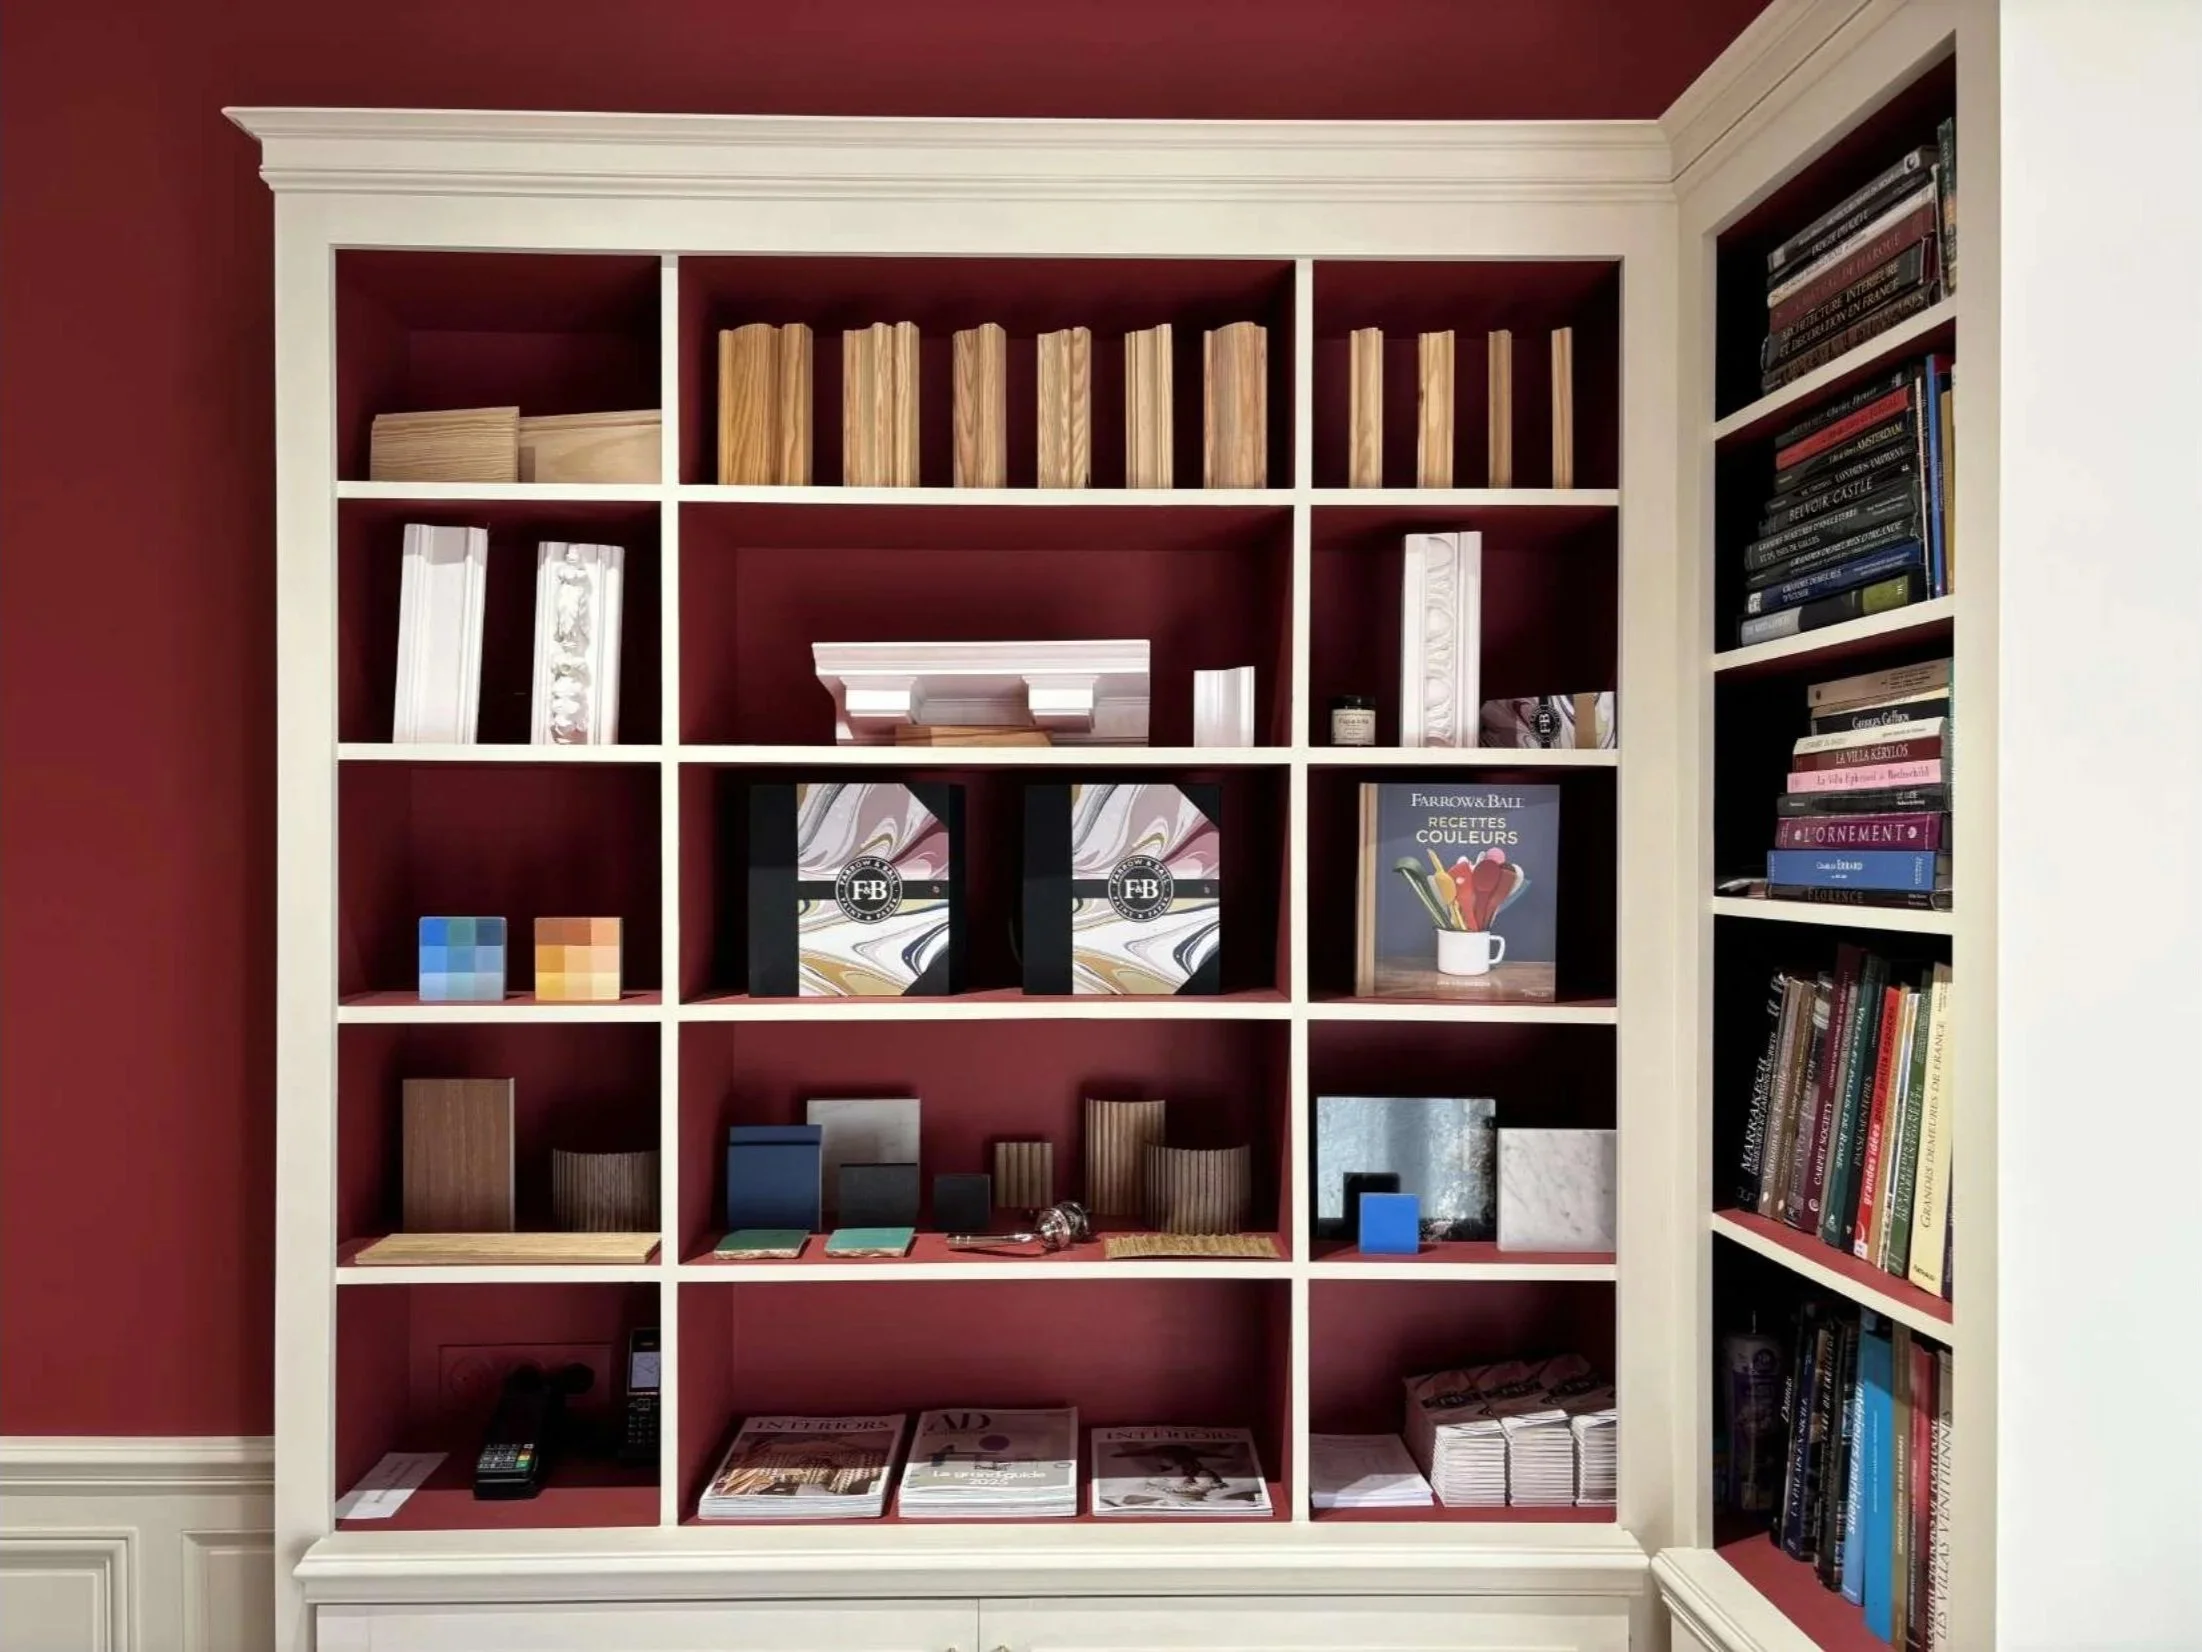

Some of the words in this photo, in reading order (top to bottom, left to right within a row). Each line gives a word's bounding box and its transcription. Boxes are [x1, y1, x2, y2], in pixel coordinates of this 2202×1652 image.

[1789, 492, 1830, 522] BELVOIR
[1834, 476, 1872, 504] CASTLE
[1847, 749, 1869, 763] VILLA
[1428, 817, 1507, 828] RECETTES
[1804, 824, 1905, 842] L'ORNEMENT
[1416, 829, 1518, 844] COULEURS
[841, 860, 871, 884] FARROW
[1112, 858, 1143, 884] FARROW
[852, 880, 888, 900] F&B
[1124, 879, 1159, 899] F&B
[840, 897, 862, 919] PAINT
[1932, 1022, 1944, 1070] FRANCE
[1930, 1074, 1940, 1092] DE
[1740, 1056, 1767, 1172] MARRAKECH
[1818, 1101, 1832, 1144] SOCIETY
[1866, 1124, 1880, 1155] idées
[1925, 1096, 1938, 1163] DEMEURES
[1836, 1131, 1846, 1168] ROME
[1814, 1147, 1828, 1185] CARPET
[1863, 1158, 1876, 1205] grandes
[1920, 1166, 1934, 1228] GRANDES
[756, 1421, 890, 1431] INTERIORS
[927, 1413, 991, 1432] AD
[1107, 1431, 1239, 1440] INTERIORS
[1846, 1460, 1862, 1534] parisiens
[1937, 1542, 1950, 1600] VILLAS
